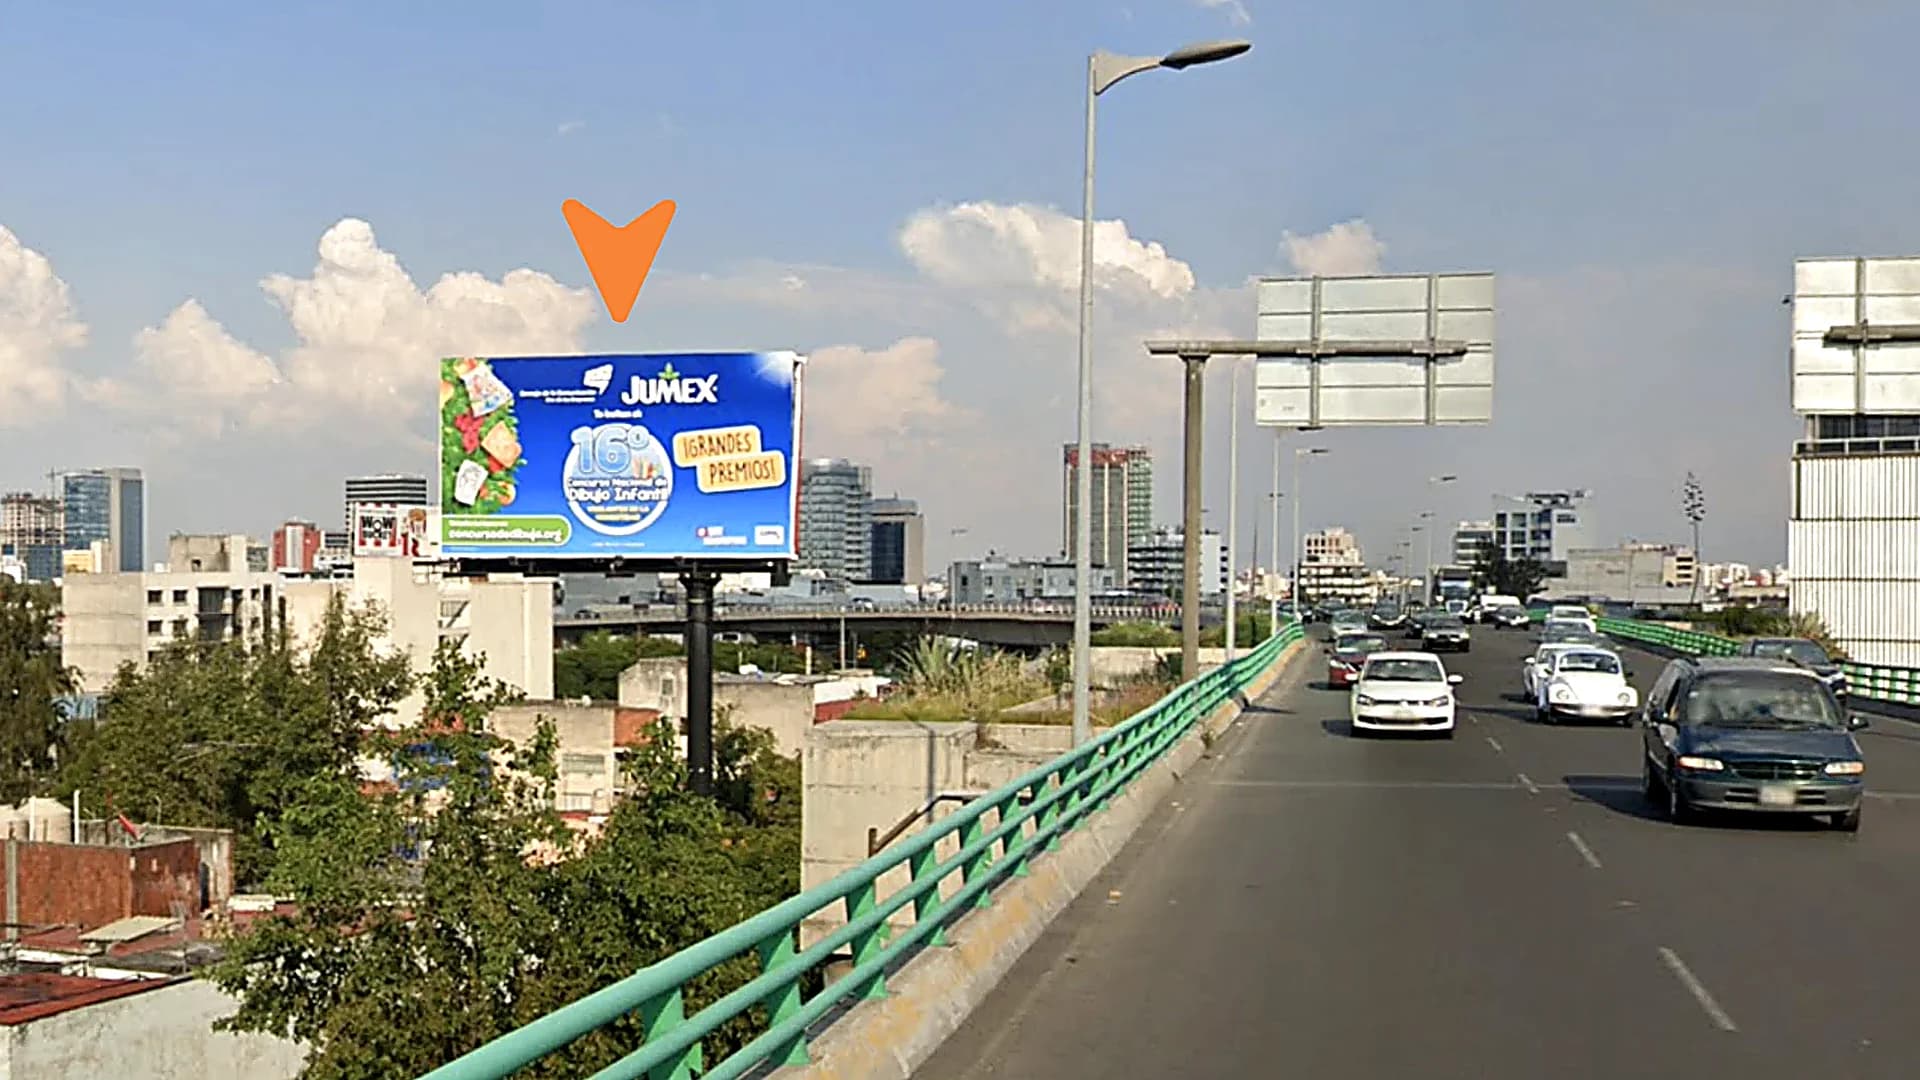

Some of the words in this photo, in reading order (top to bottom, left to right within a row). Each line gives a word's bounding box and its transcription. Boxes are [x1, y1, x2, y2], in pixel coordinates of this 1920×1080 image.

[621, 374, 718, 405] JUMEX
[709, 459, 777, 485] PREMIOS!
[569, 488, 610, 503] Dibujo
[615, 487, 668, 501] Infantil
[360, 516, 396, 533] WOW
